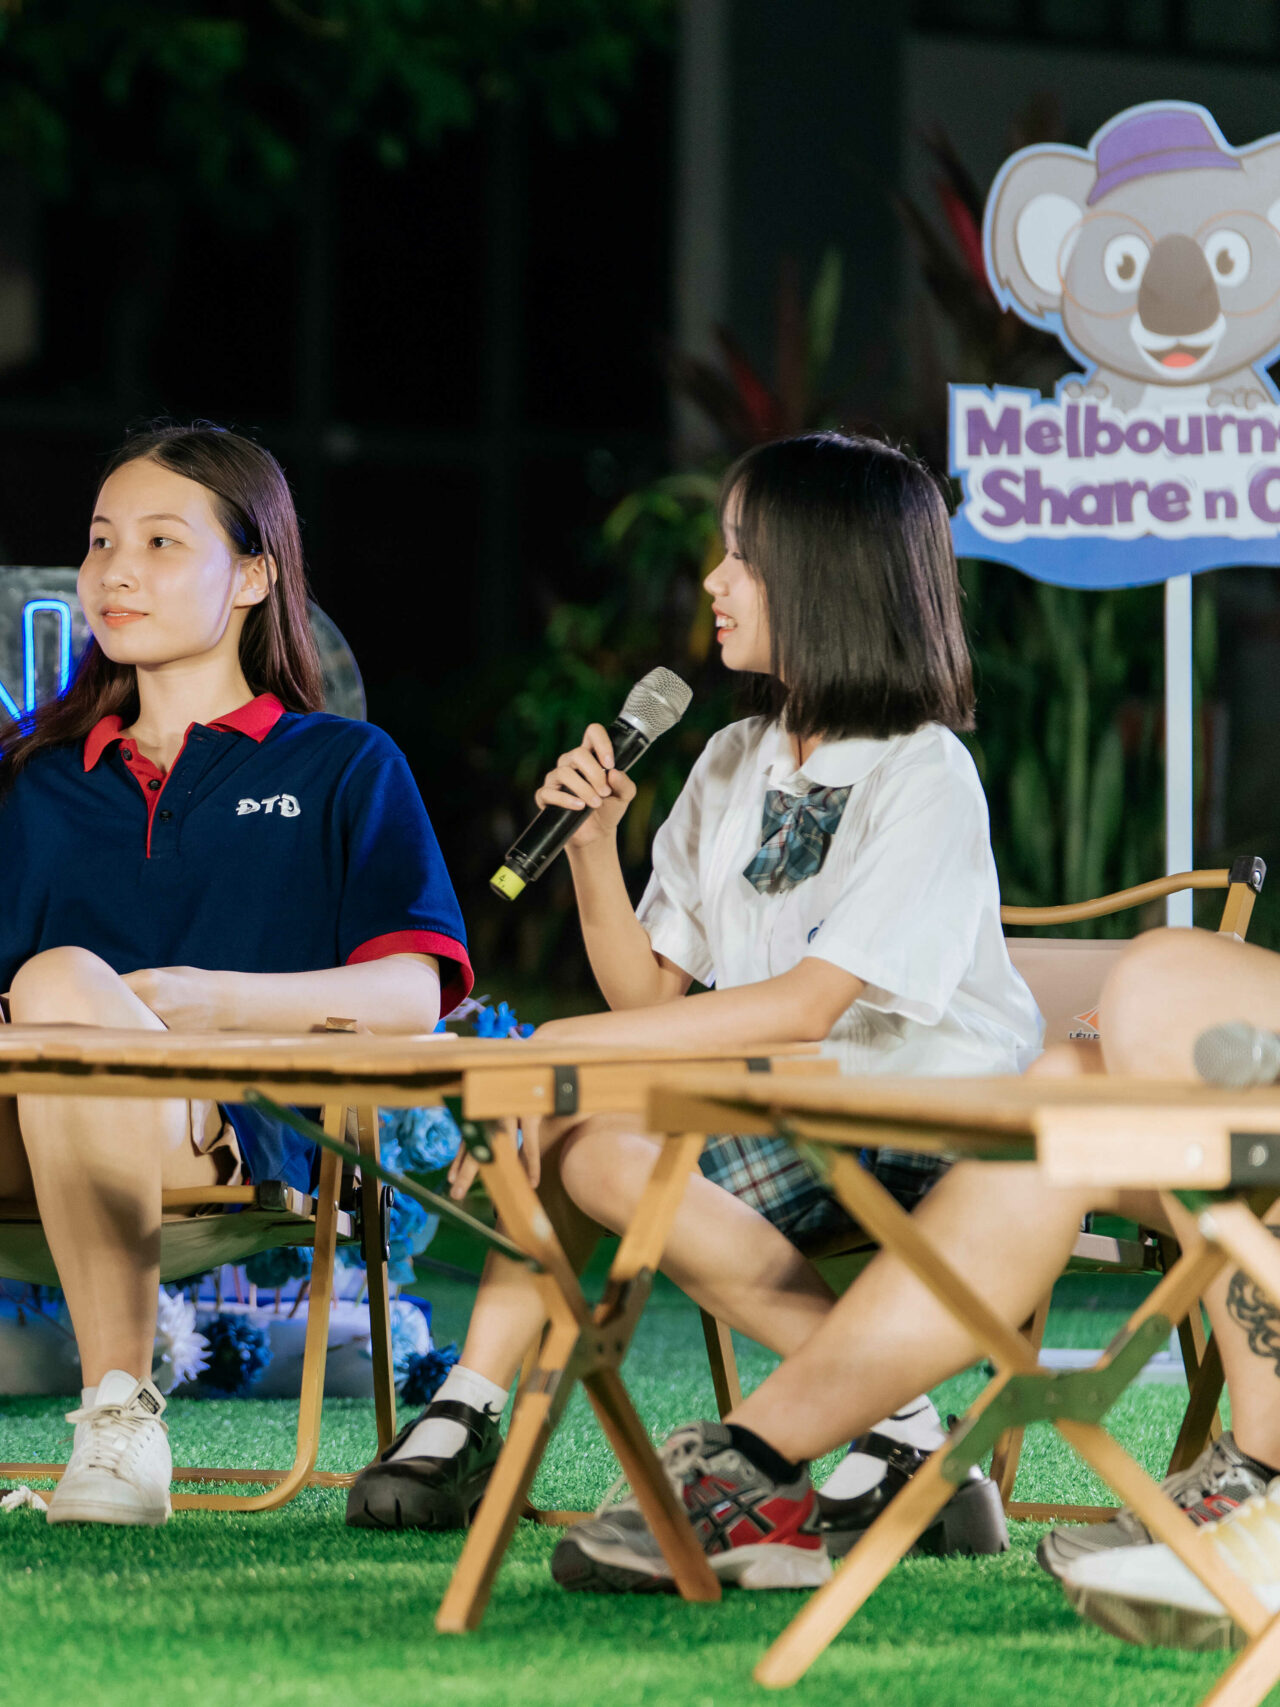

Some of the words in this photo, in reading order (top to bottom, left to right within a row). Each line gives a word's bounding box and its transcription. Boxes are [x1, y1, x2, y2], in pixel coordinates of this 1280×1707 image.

[966, 404, 1280, 458] Melbourn
[981, 468, 1192, 528] Share
[1204, 489, 1238, 519] n
